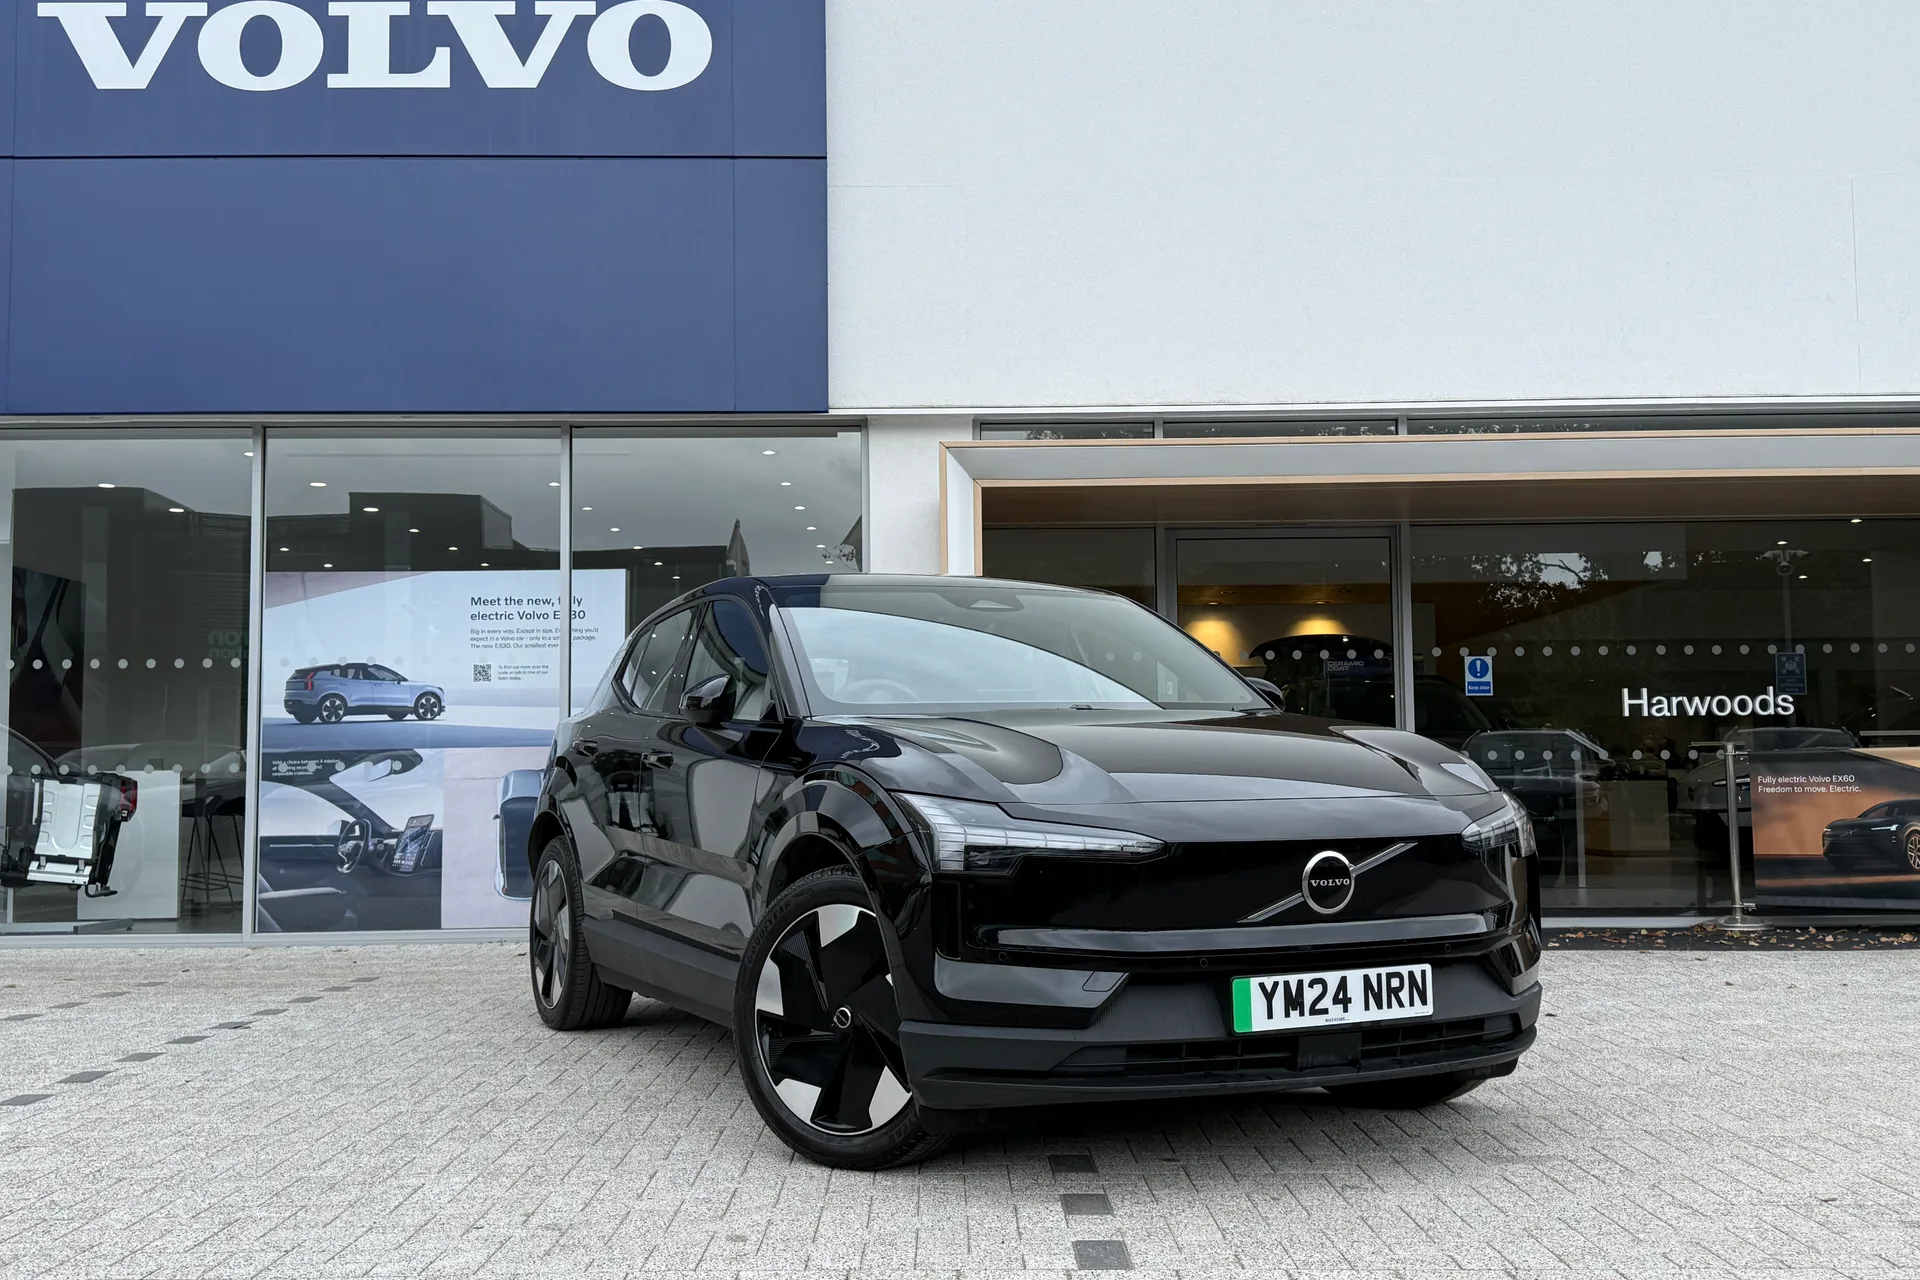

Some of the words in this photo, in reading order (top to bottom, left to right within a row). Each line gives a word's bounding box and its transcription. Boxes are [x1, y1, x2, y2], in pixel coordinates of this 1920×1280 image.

[37, 0, 712, 91] VOLVO
[470, 596, 501, 606] Meet
[504, 596, 523, 606] the
[527, 598, 555, 607] new,
[558, 595, 583, 607] fly
[470, 610, 514, 621] electric
[517, 610, 550, 620] Volvo
[553, 610, 586, 620] E30
[516, 627, 535, 635] Except
[1621, 685, 1795, 717] Harwoods
[1757, 775, 1776, 784] Fully
[1778, 775, 1807, 784] electric
[1808, 774, 1831, 783] Volvo
[1832, 774, 1855, 783] EX60
[1758, 785, 1792, 793] Freedom
[1829, 784, 1862, 793] Electric.
[1310, 878, 1350, 887] VOLVO
[1258, 975, 1352, 1020] YM24
[1362, 969, 1428, 1012] NRN
